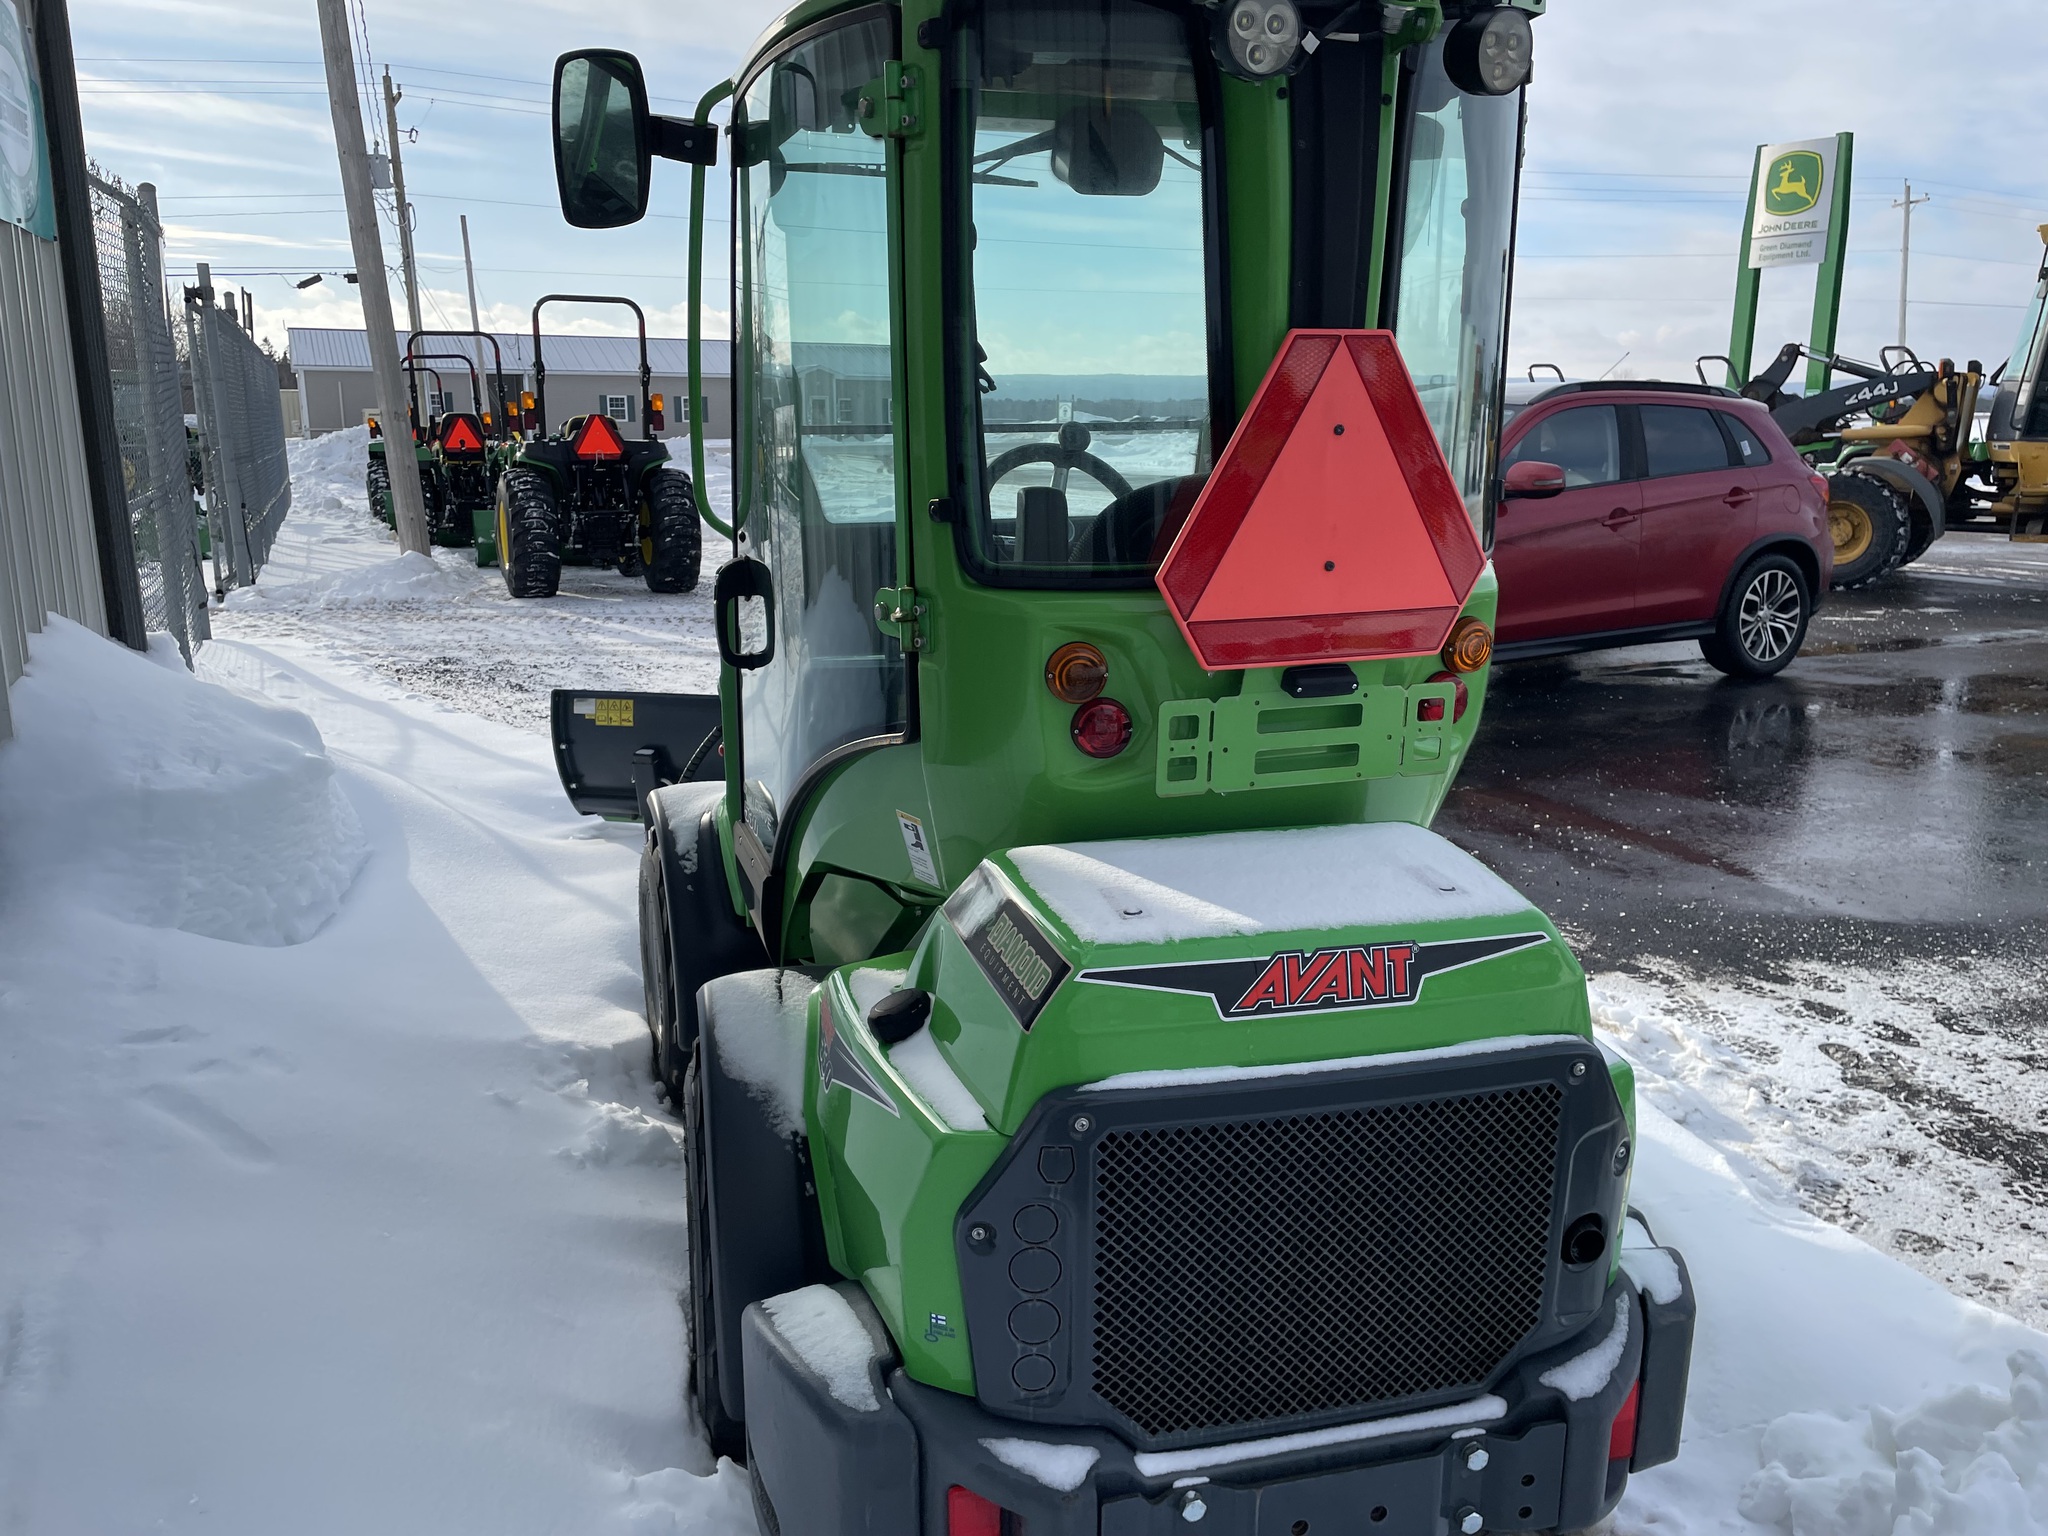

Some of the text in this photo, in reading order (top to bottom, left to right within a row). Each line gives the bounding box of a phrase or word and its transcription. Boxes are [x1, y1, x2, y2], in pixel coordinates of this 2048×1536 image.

[1758, 220, 1818, 233] JOHN DEERE
[1758, 251, 1793, 262] Equipment
[1759, 240, 1813, 252] Green Diamond
[979, 942, 1027, 1006] EQUIPMENT
[986, 911, 1053, 1001] DIAMOND
[1230, 944, 1415, 1012] AVANT
